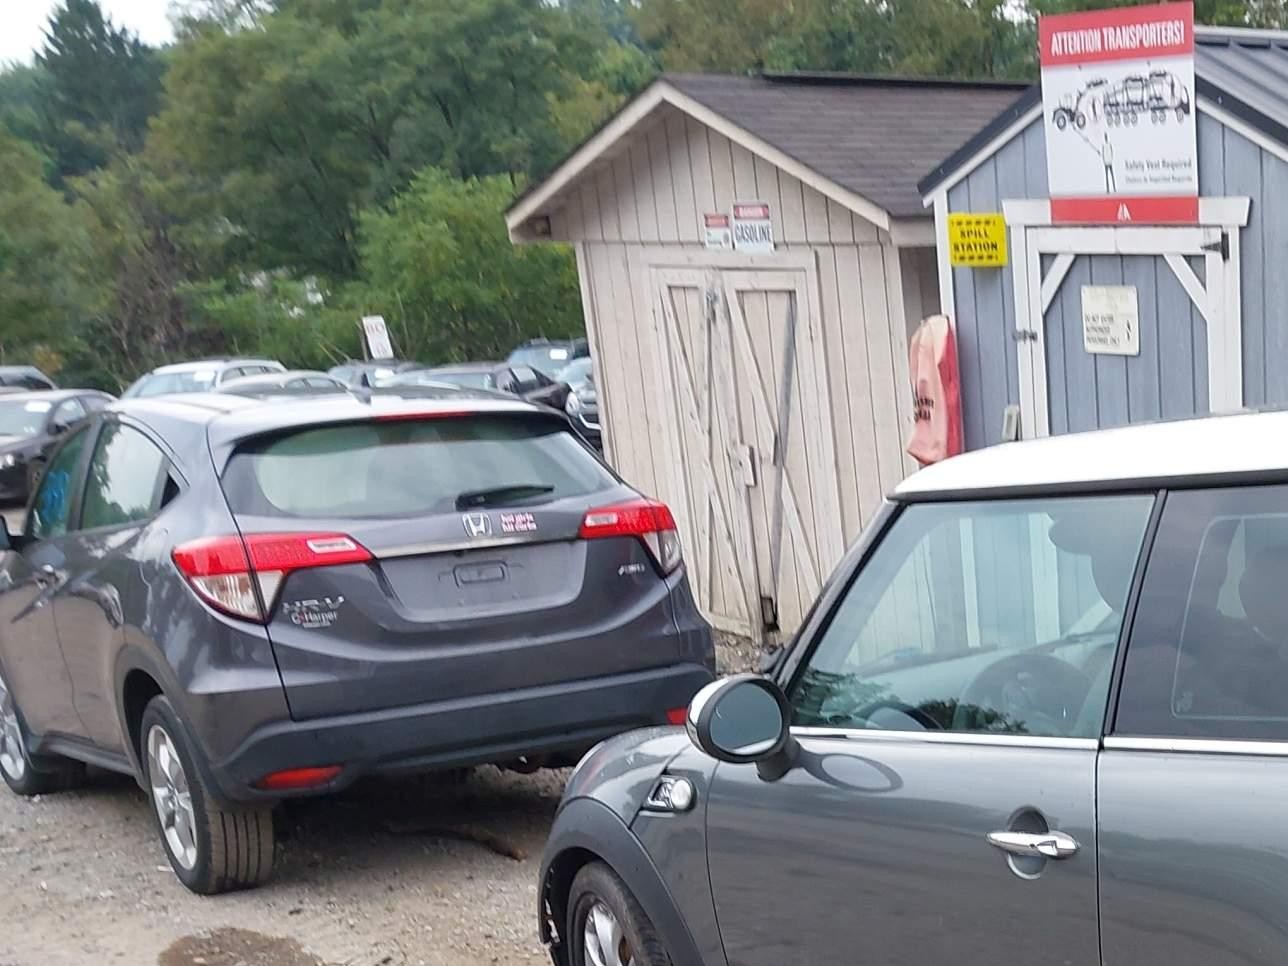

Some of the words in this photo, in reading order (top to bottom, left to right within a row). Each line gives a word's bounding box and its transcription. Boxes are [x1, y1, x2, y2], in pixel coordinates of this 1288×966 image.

[1051, 28, 1101, 57] ATTENTION
[1102, 20, 1185, 52] TRANSPORTERS!
[735, 222, 772, 243] GASOLINE
[960, 229, 988, 240] SPILL
[953, 241, 998, 252] STATION
